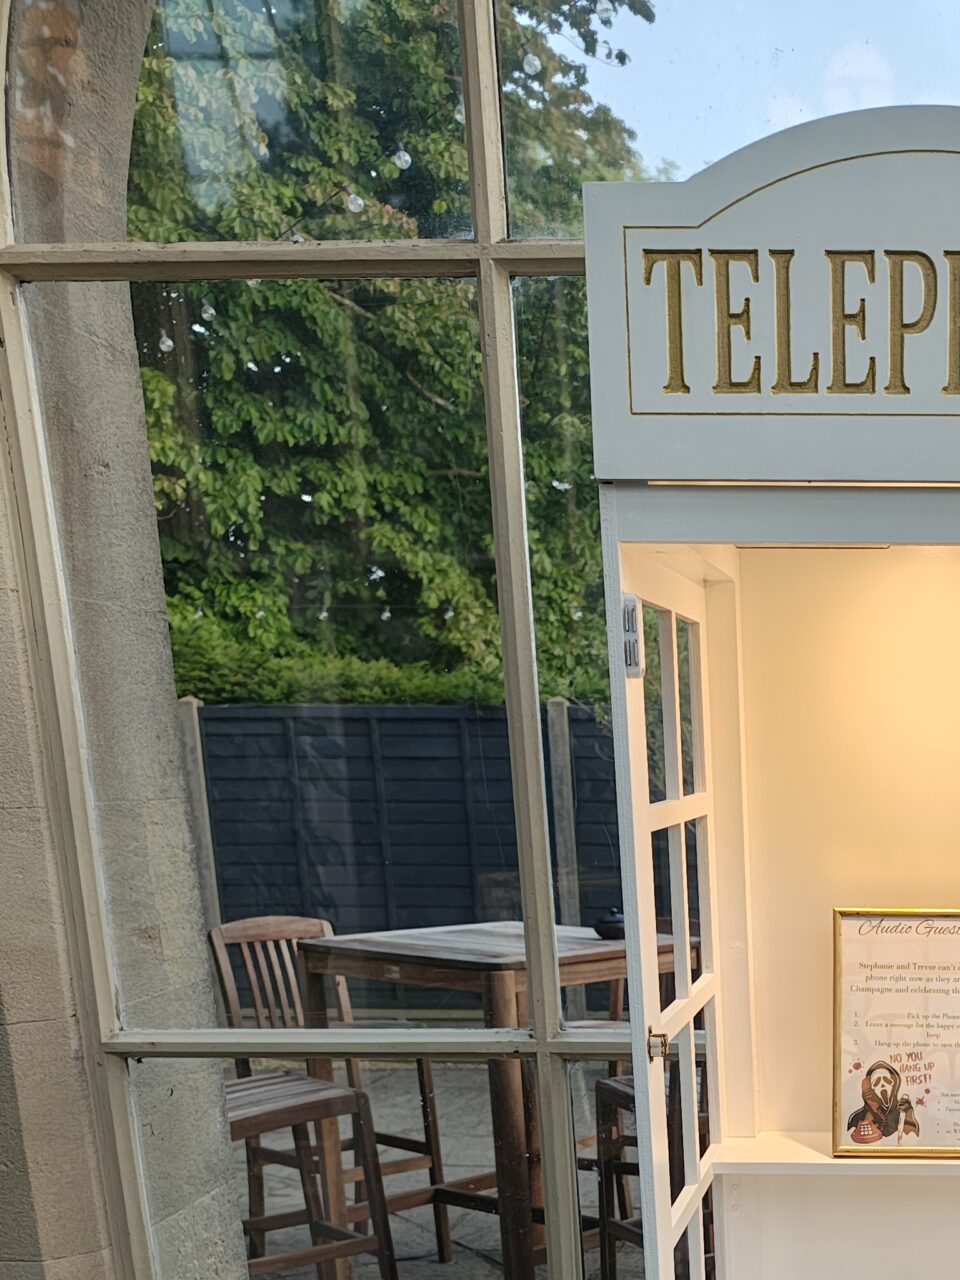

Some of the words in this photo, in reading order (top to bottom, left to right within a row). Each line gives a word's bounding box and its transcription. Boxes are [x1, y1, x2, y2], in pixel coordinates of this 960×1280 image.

[858, 918, 912, 936] Audio
[858, 962, 895, 972] Stephanie
[896, 962, 910, 970] and
[912, 962, 936, 971] Trevor
[938, 963, 956, 971] can't
[865, 974, 888, 983] phone
[889, 974, 907, 983] right
[935, 975, 951, 984] they
[850, 985, 893, 995] Champagne
[910, 986, 951, 996] celebrating
[936, 1022, 955, 1031] happy
[875, 1040, 891, 1048] Hang
[912, 1041, 931, 1049] phone
[890, 1053, 902, 1064] NO
[905, 1051, 923, 1062] YOU
[900, 1063, 921, 1073] HANG
[924, 1062, 935, 1072] UP
[905, 1074, 932, 1086] FIRST!
